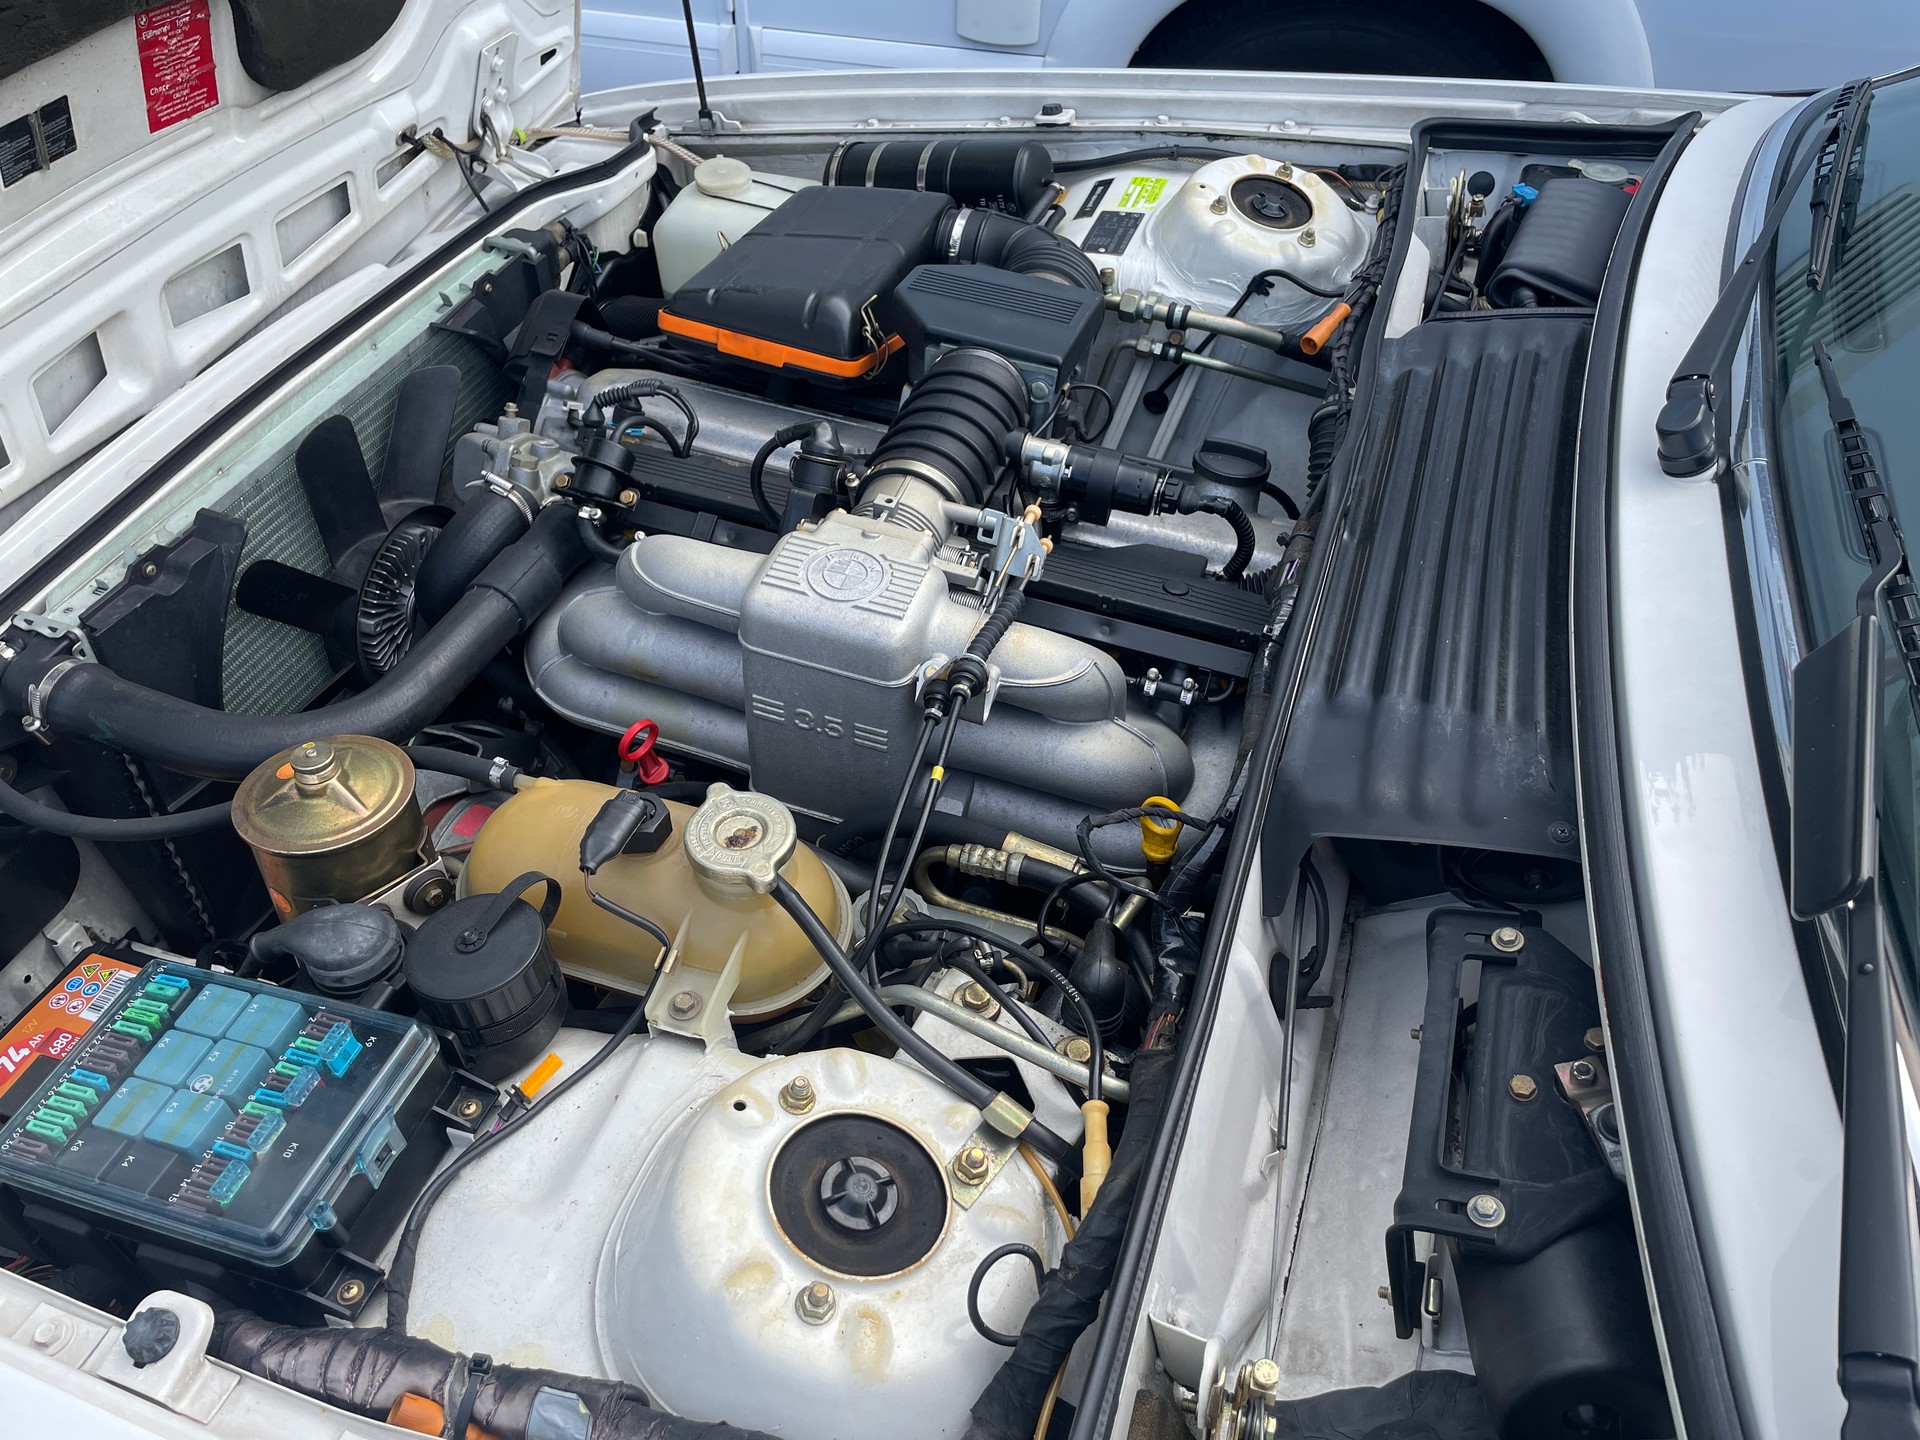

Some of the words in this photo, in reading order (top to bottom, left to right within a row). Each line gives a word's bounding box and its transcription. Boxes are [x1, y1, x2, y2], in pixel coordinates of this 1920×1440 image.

[794, 708, 845, 739] 3.5
[149, 973, 157, 982] 17
[135, 989, 146, 997] 18
[198, 990, 211, 1001] K5
[127, 1000, 135, 1008] 19
[248, 1003, 259, 1013] K1
[115, 1010, 125, 1020] 20
[22, 1018, 39, 1035] 12V
[104, 1023, 115, 1032] 21
[28, 1034, 45, 1048] Ah
[48, 1033, 73, 1055] 680
[92, 1035, 105, 1045] 22
[157, 1037, 171, 1048] K6
[365, 1035, 378, 1048] K9
[82, 1047, 94, 1057] 23
[207, 1050, 221, 1062] K2
[70, 1059, 83, 1070] 24
[59, 1072, 72, 1083] 25
[47, 1085, 60, 1096] 26
[116, 1087, 129, 1099] K7
[37, 1098, 49, 1110] 27
[165, 1101, 180, 1113] K3
[26, 1110, 38, 1121] 28
[224, 1121, 237, 1131] 10
[12, 1127, 24, 1138] 29
[1, 1138, 14, 1150] 30
[70, 1140, 85, 1152] K8
[202, 1149, 214, 1159] 12
[283, 1142, 300, 1159] K10
[121, 1155, 136, 1167] K4
[191, 1164, 203, 1173] 13
[180, 1178, 192, 1188] 14
[168, 1193, 180, 1203] 15
